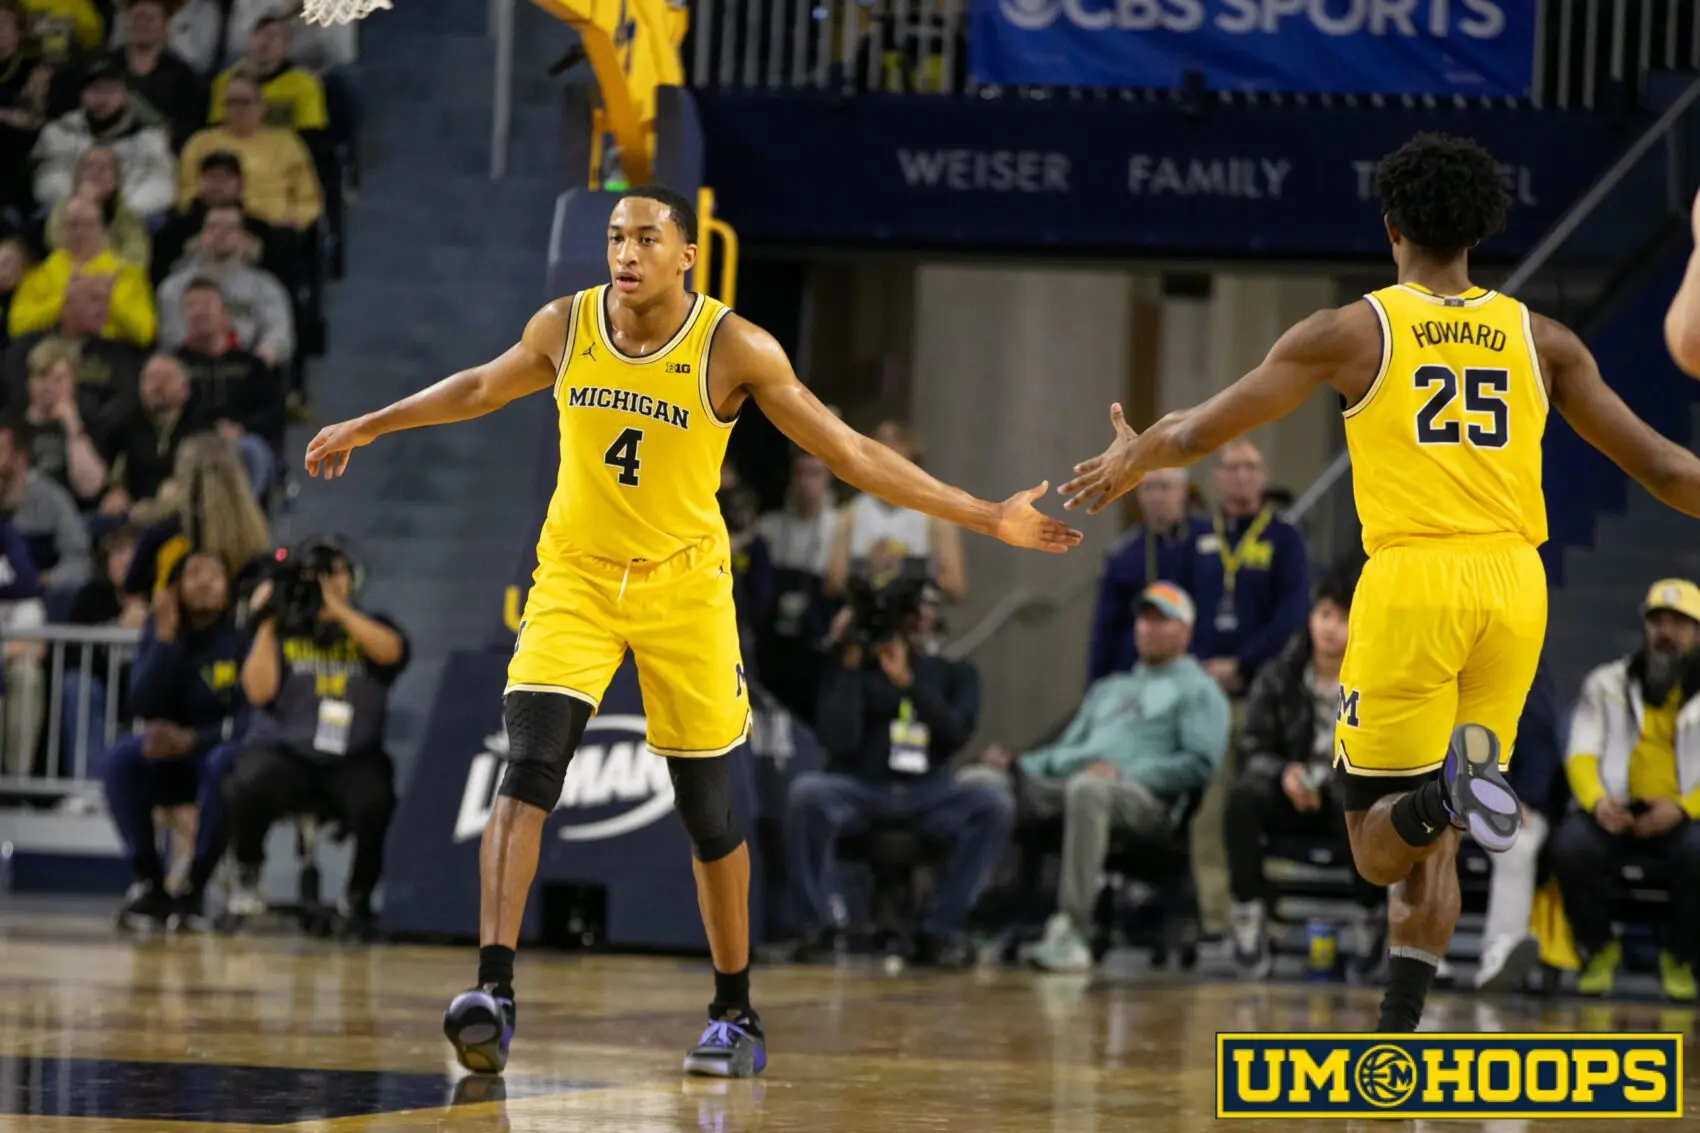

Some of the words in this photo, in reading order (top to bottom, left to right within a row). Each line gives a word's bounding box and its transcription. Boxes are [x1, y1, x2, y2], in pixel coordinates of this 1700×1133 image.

[898, 149, 1071, 194] WEISER
[1128, 154, 1293, 200] FAMILY
[1411, 320, 1507, 352] HOWARD
[568, 387, 690, 430] MICHIGAN
[1412, 364, 1509, 450] 25
[604, 427, 644, 488] 4
[1337, 683, 1360, 728] M
